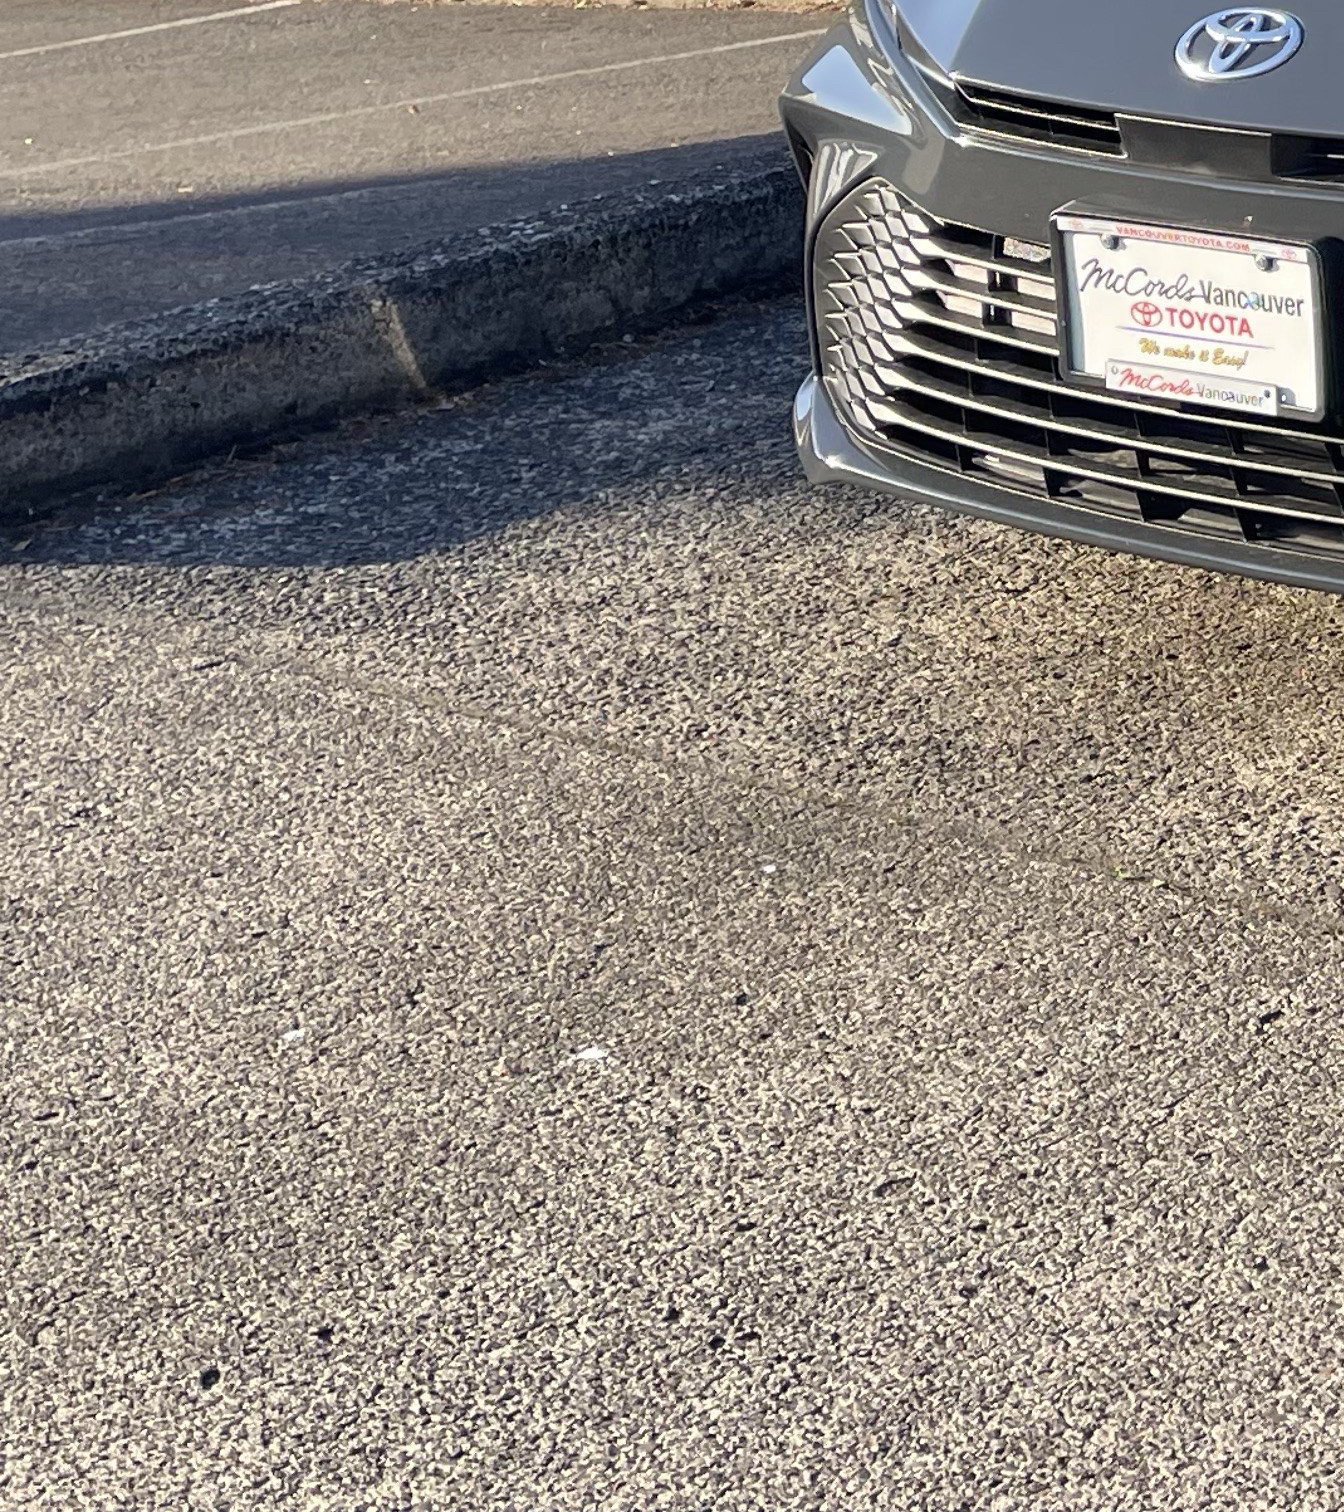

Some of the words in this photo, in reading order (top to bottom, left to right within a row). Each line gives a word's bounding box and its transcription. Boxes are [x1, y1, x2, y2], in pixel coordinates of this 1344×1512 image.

[1116, 226, 1250, 252] VANCOUVERTOYOTA.COM
[1080, 258, 1199, 301] McCords
[1199, 279, 1305, 318] Vancouver
[1165, 307, 1255, 339] TOYOTA
[1138, 337, 1161, 356] We
[1163, 344, 1195, 361] make
[1118, 367, 1197, 396] McCords
[1196, 382, 1265, 407] Vancouver
